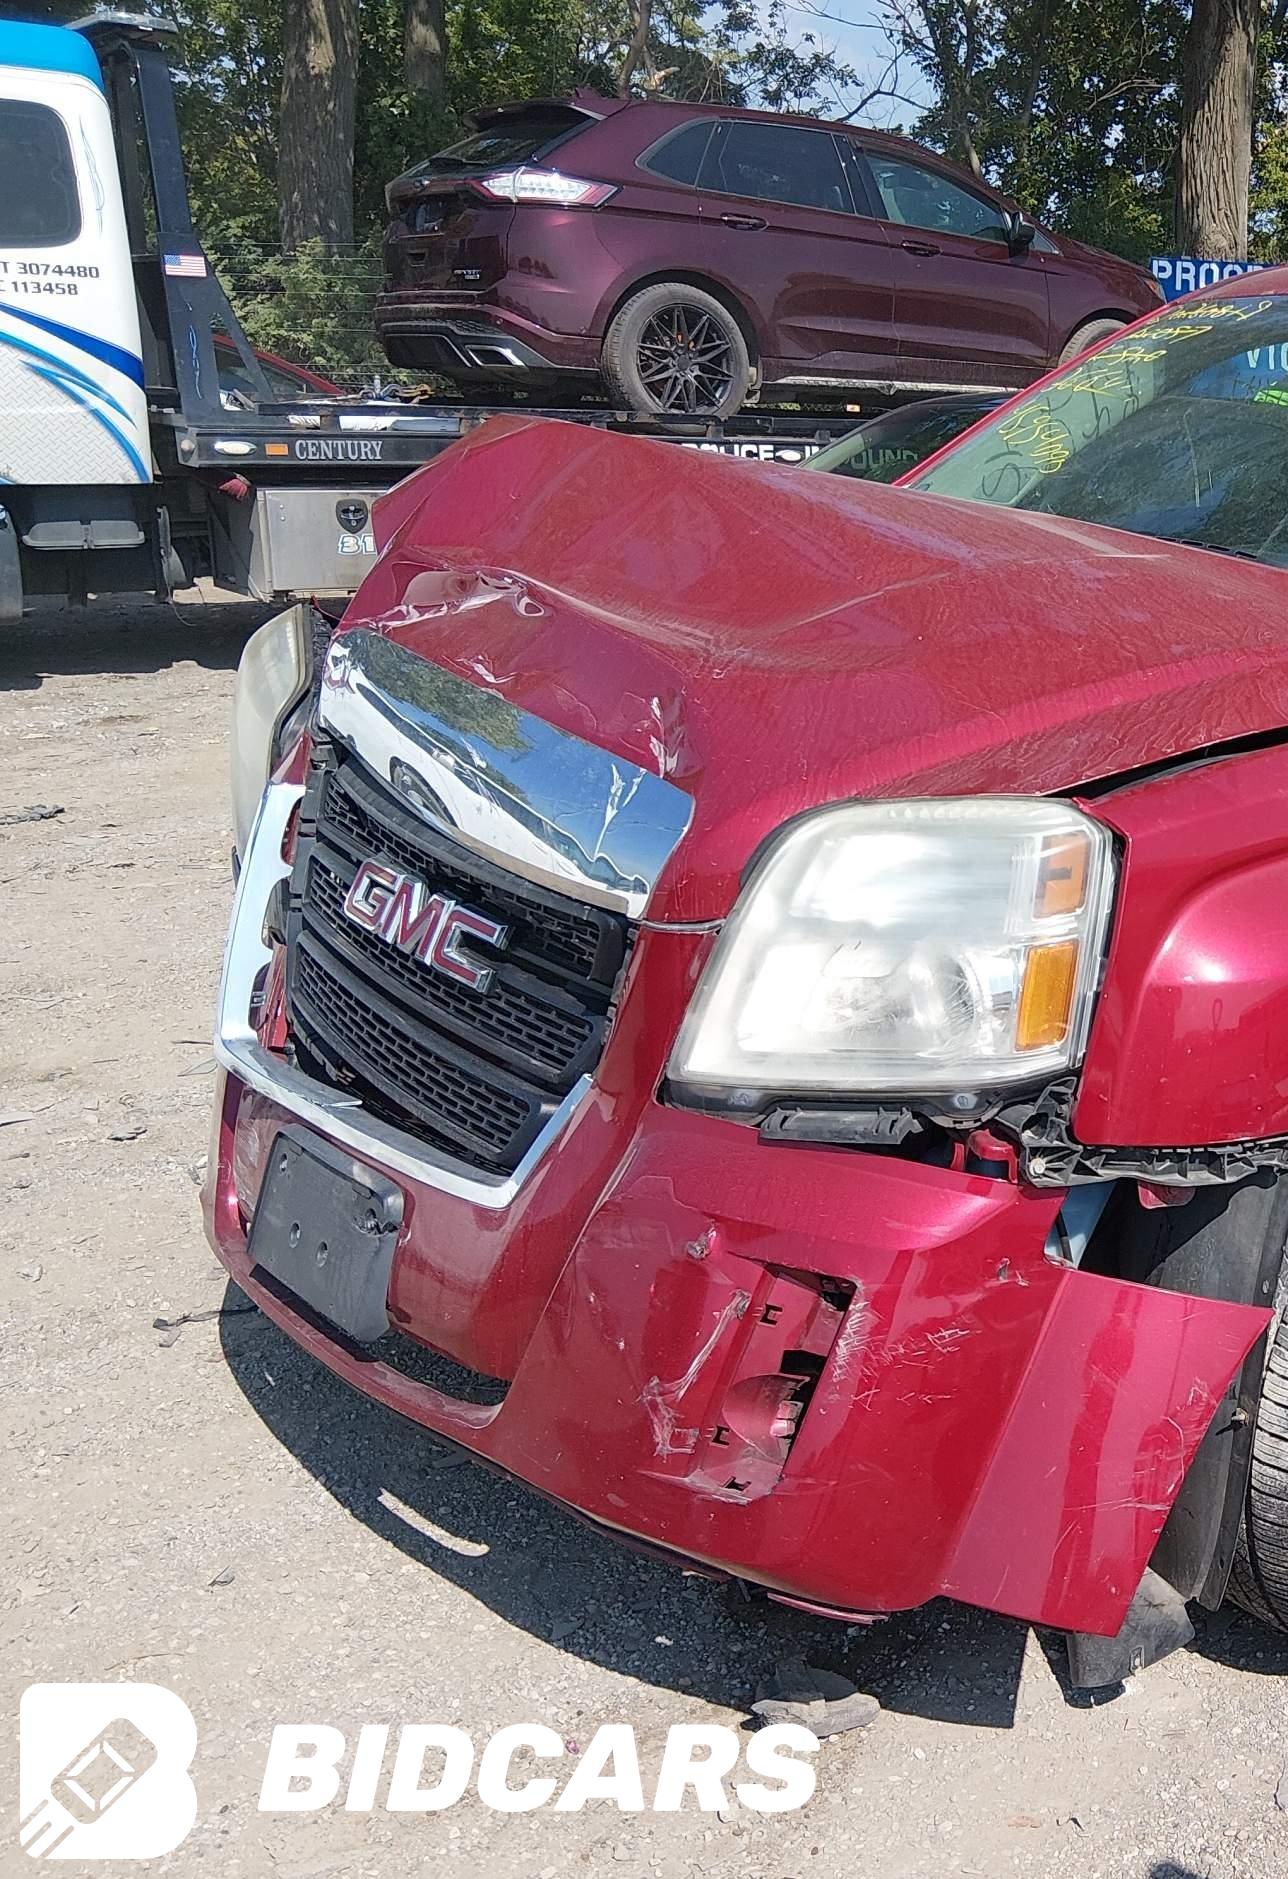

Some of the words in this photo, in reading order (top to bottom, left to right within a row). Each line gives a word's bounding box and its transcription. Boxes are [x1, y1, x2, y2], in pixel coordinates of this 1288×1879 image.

[16, 262, 100, 279] 3074480
[11, 281, 79, 296] 113458
[294, 439, 383, 461] CENTURY
[344, 859, 509, 994] GMC
